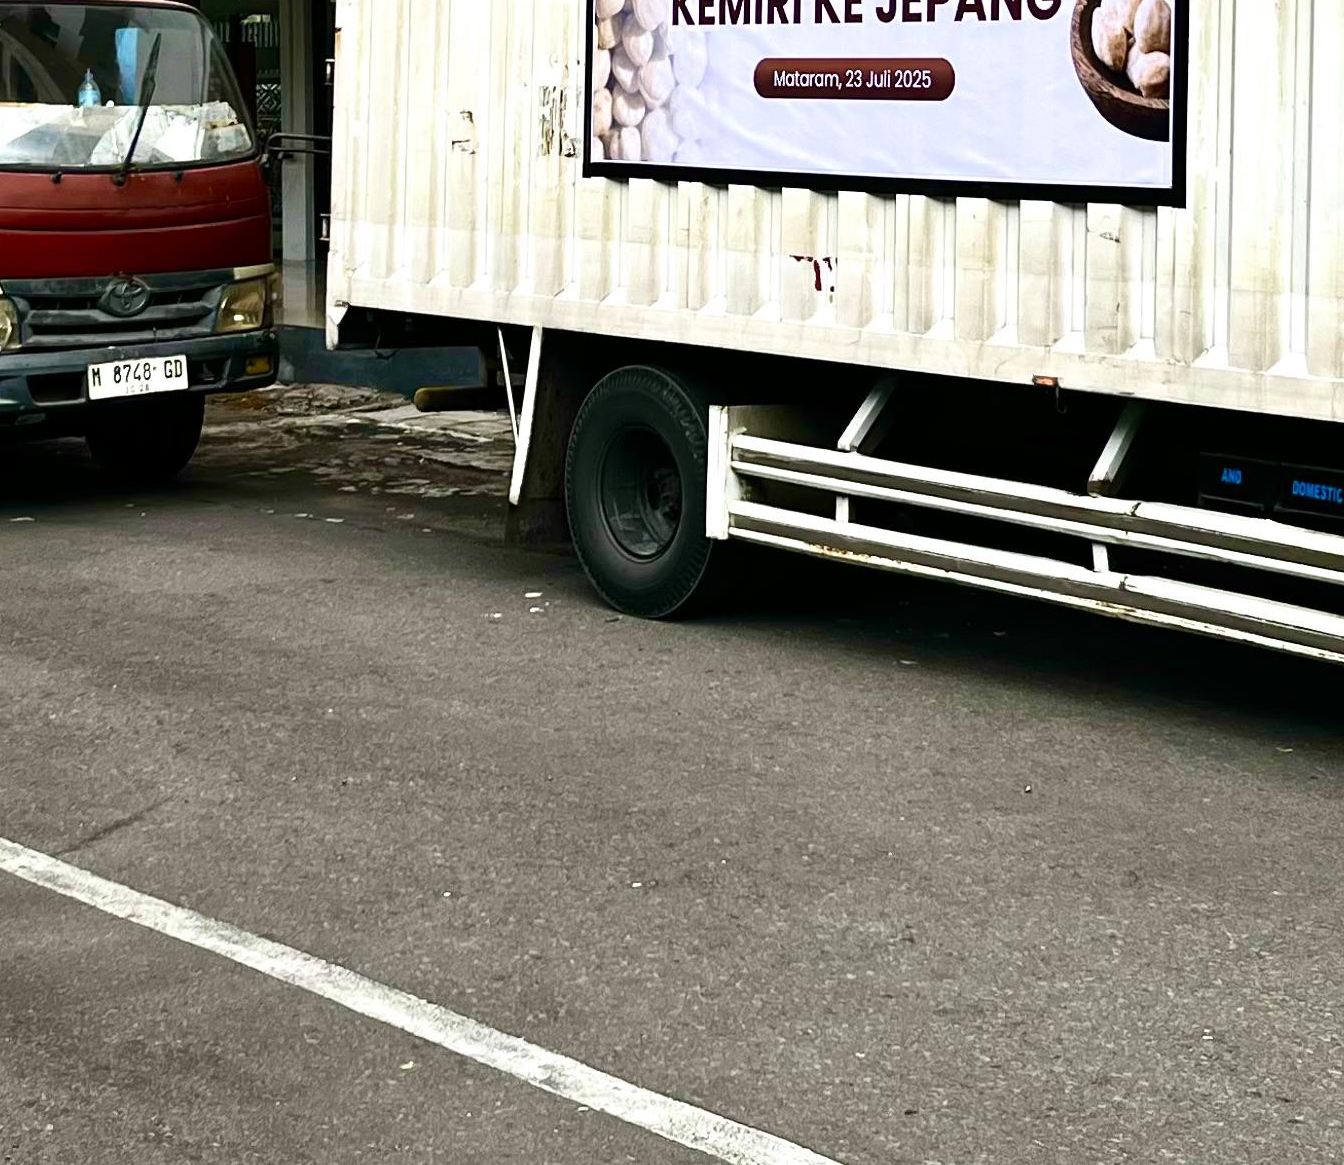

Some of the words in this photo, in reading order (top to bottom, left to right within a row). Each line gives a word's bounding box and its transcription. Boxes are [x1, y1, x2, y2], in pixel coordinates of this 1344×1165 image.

[773, 69, 843, 91] Mataram,
[845, 70, 863, 89] 23
[866, 69, 892, 89] Juli
[894, 69, 932, 89] 2025
[113, 362, 151, 384] 8748
[164, 359, 183, 379] GD
[1220, 467, 1242, 485] AND
[1292, 480, 1344, 505] DOMESTIC
